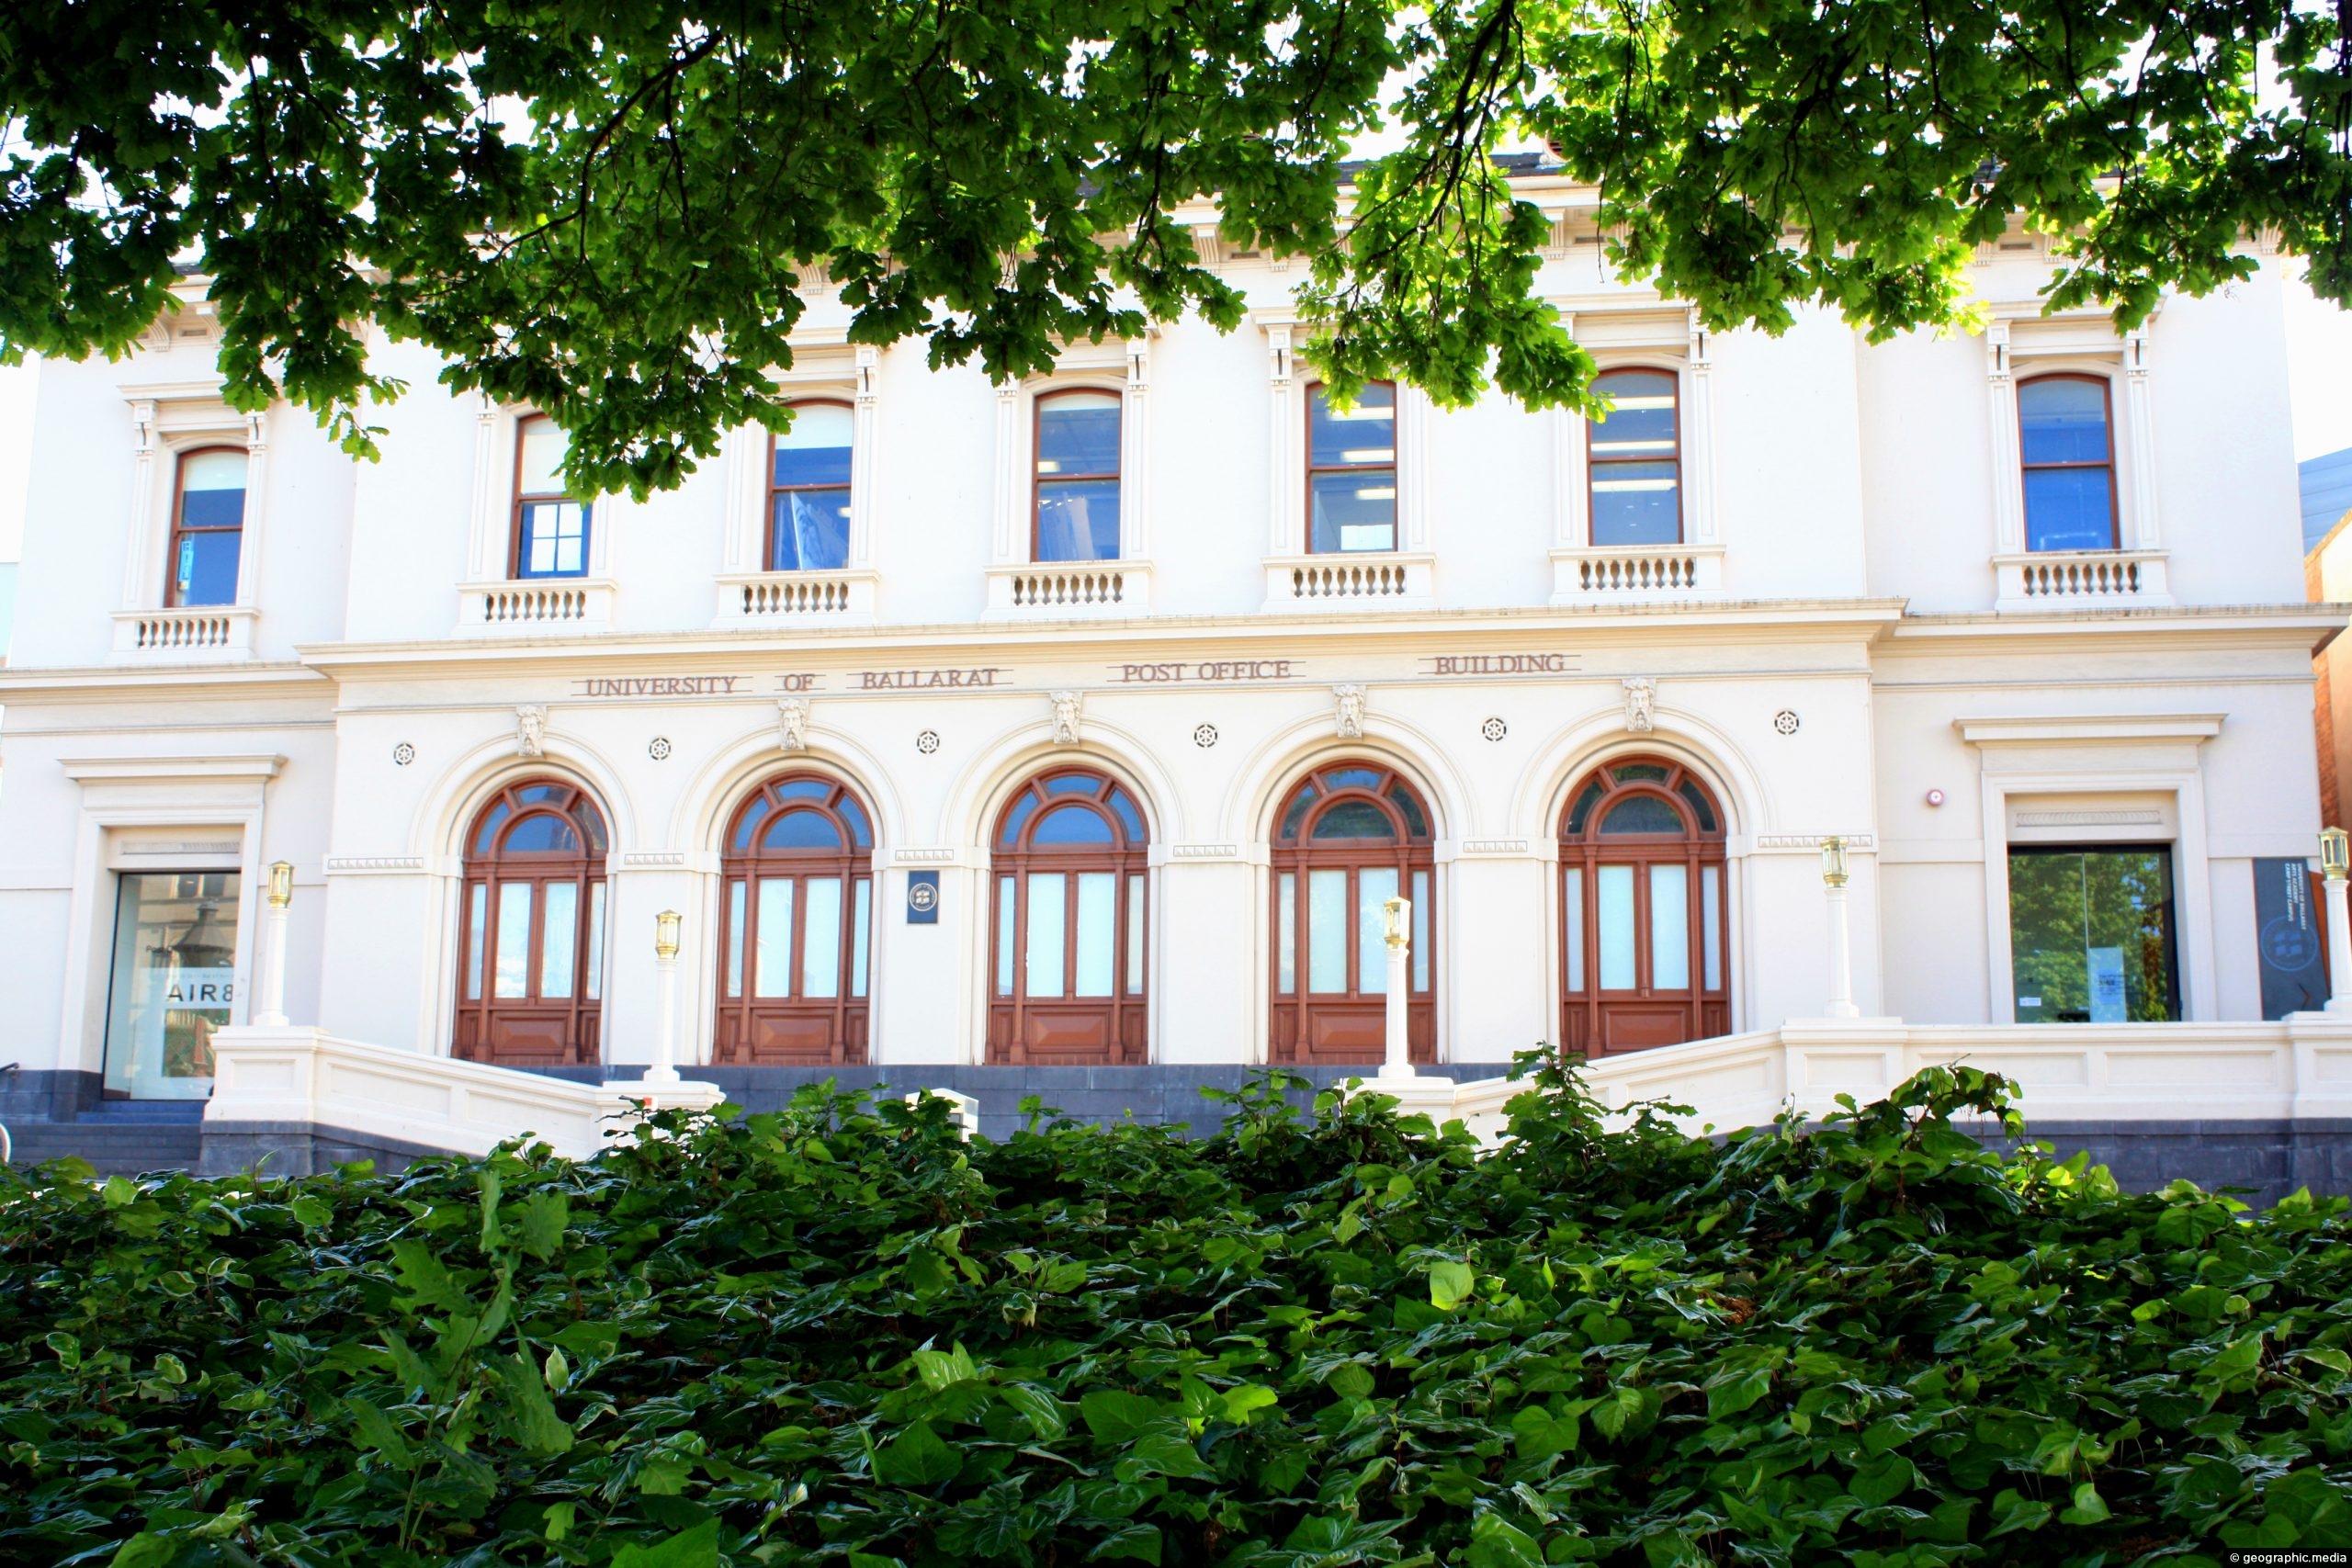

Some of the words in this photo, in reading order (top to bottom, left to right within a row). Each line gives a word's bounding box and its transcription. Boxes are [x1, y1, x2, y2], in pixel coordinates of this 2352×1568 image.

[586, 676, 738, 697] UNIVERSITY
[783, 673, 816, 693] OF
[862, 668, 1000, 691] BALLARAT
[1123, 664, 1188, 682] POST
[1198, 660, 1291, 681] OFFICE
[1434, 654, 1566, 675] BUILDING
